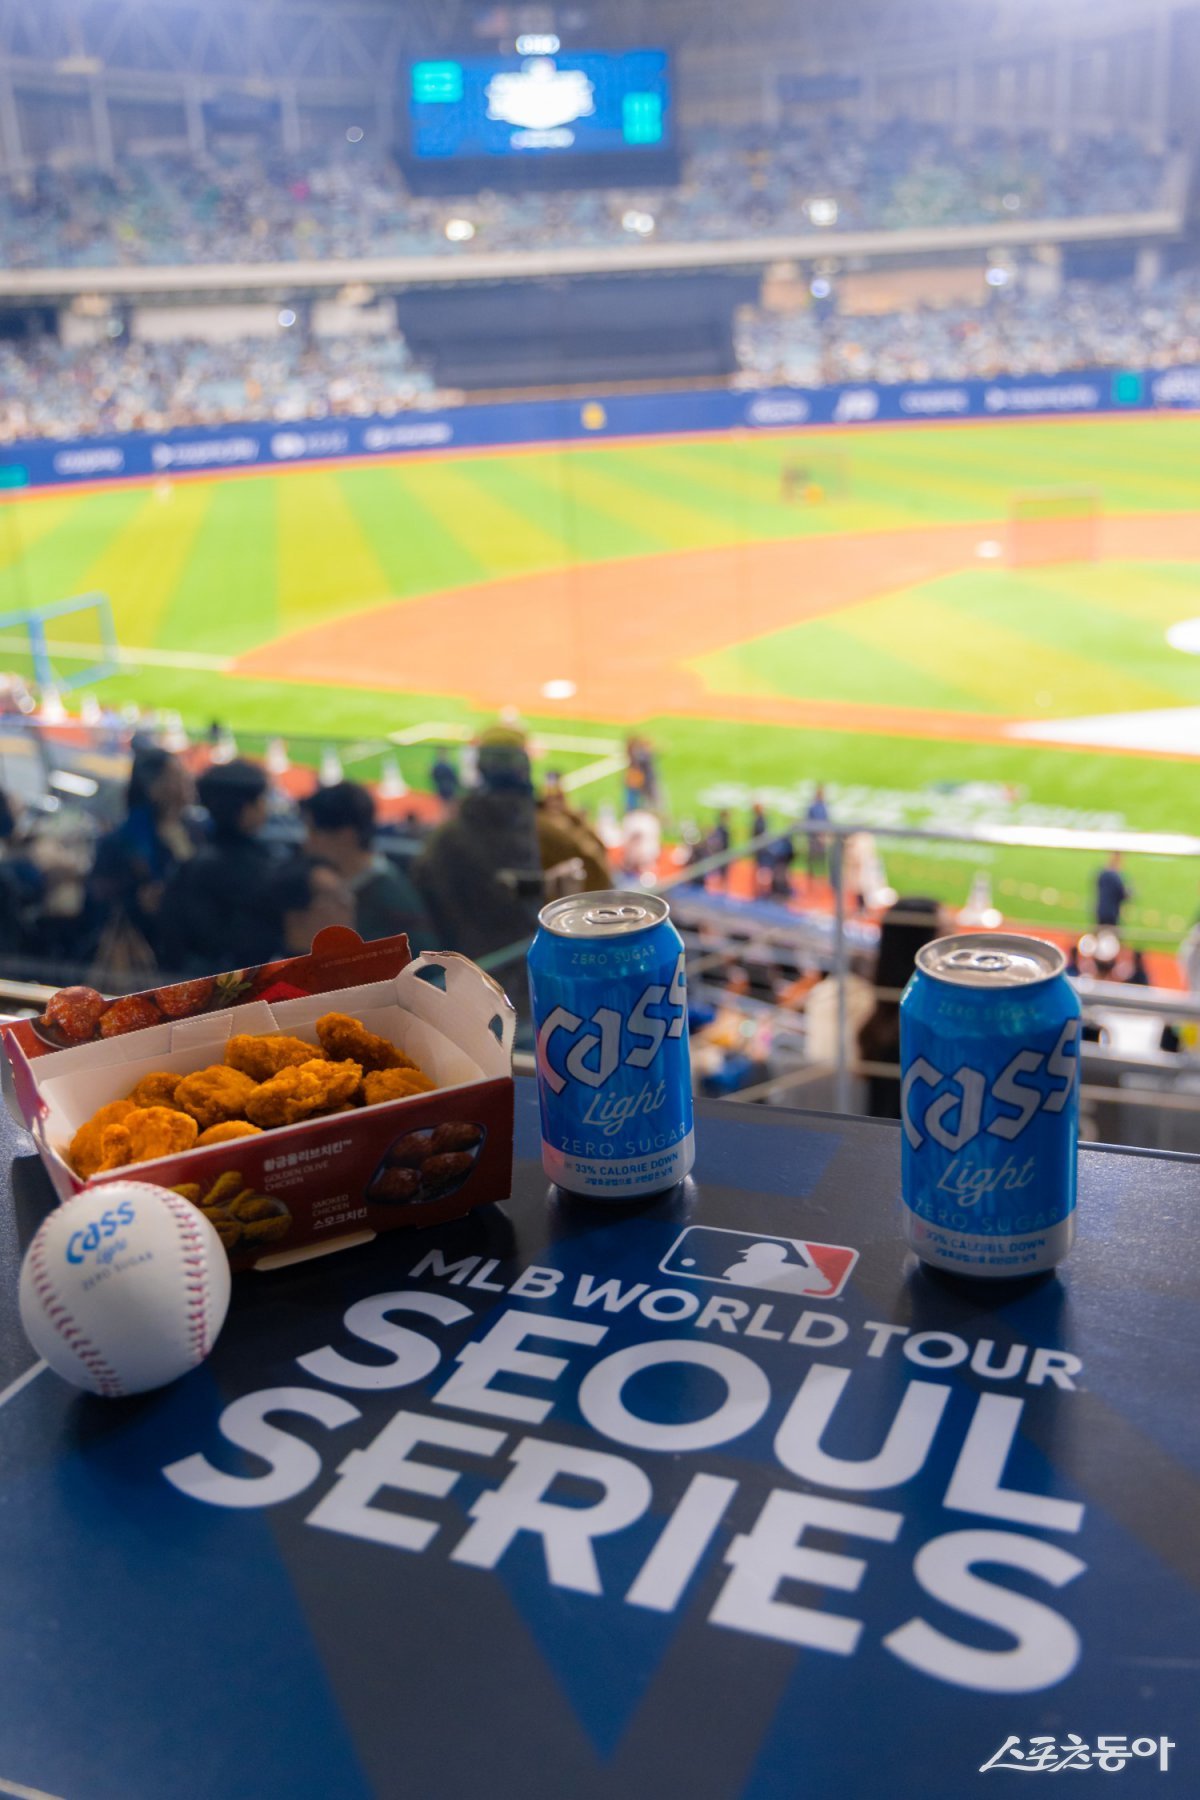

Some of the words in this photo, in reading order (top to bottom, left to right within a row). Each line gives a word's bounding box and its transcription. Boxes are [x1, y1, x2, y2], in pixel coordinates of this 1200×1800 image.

[571, 952, 608, 965] ZERO
[614, 944, 657, 964] SUGAR
[582, 1079, 667, 1136] Light
[561, 1136, 614, 1157] ZERO
[626, 1122, 686, 1155] SUGAR
[264, 1168, 302, 1184] GOLDEN
[303, 1160, 329, 1174] OLIVE
[575, 1163, 596, 1175] 33%
[599, 1162, 648, 1176] CALORIE
[650, 1151, 679, 1169] DOWN
[264, 1176, 304, 1191] CHICKEN
[937, 1156, 1035, 1207] Light
[312, 1194, 350, 1209] SMOKED
[312, 1202, 351, 1217] CHICKEN
[313, 1207, 368, 1230] 스모크치킨
[914, 1198, 967, 1229] ZERO
[982, 1208, 1058, 1233] SUGAR
[1008, 1238, 1047, 1253] DOWN
[408, 1248, 565, 1300] MLB
[572, 1273, 850, 1348] WORLD
[864, 1320, 1085, 1391] TOUR
[296, 1290, 1086, 1534] SEOUL
[161, 1386, 1088, 1694] SERIES
